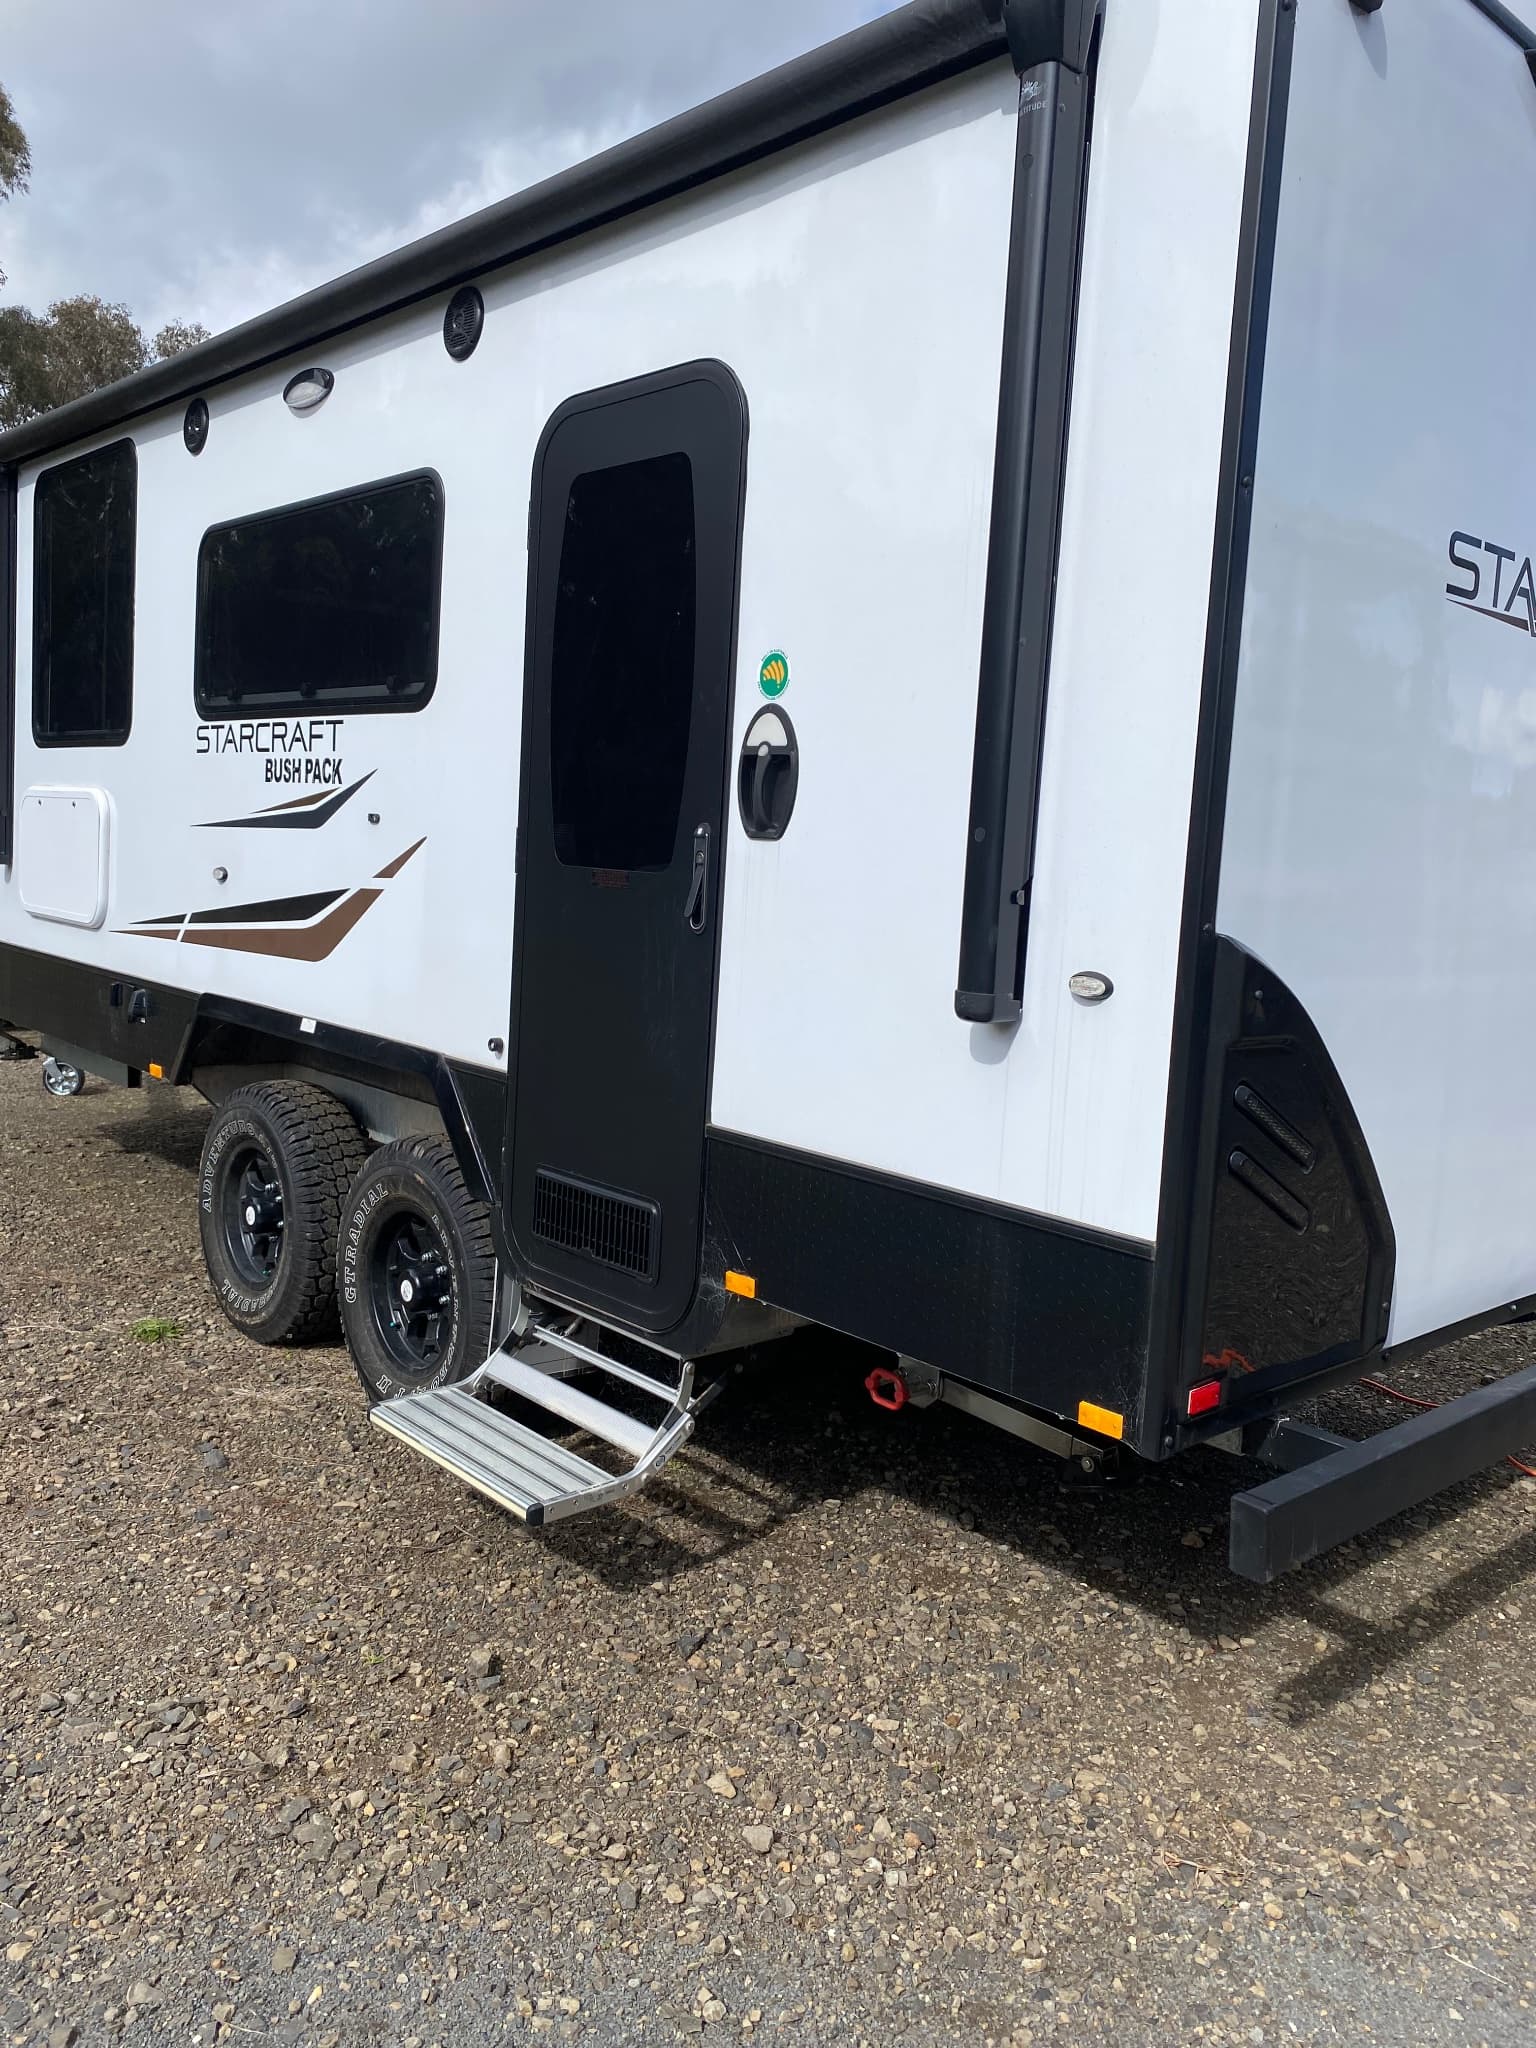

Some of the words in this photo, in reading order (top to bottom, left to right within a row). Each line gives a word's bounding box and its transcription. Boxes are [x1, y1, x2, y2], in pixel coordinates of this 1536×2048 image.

[196, 719, 344, 753] STARCRAFT
[264, 758, 301, 783] BUSH
[304, 758, 343, 785] PACK
